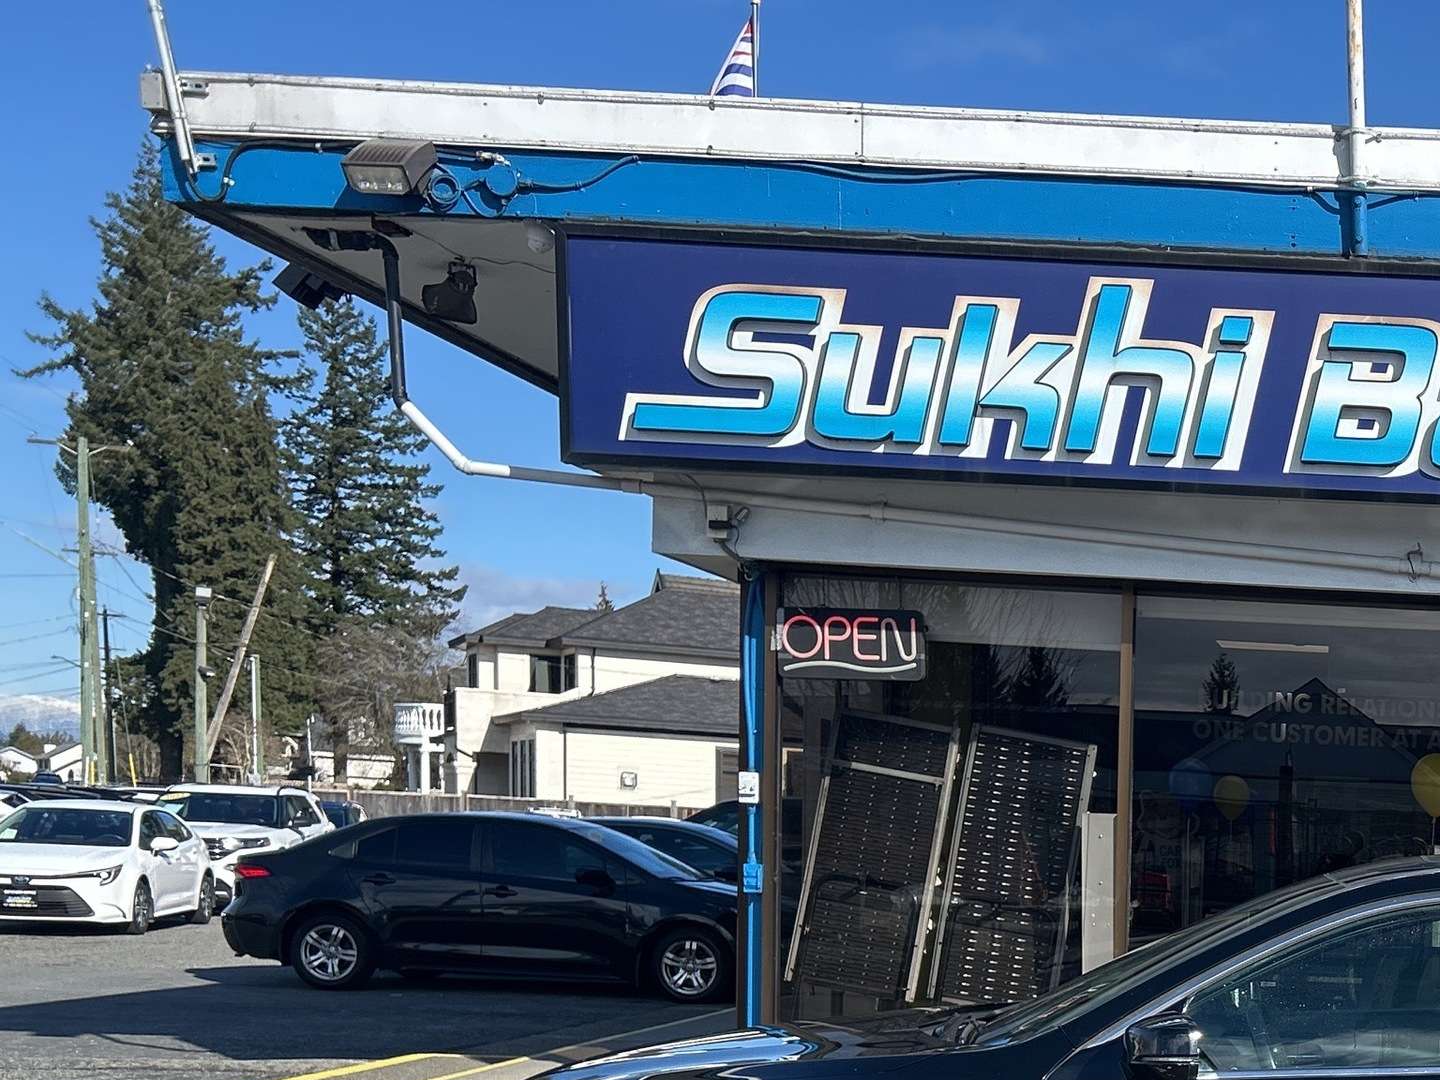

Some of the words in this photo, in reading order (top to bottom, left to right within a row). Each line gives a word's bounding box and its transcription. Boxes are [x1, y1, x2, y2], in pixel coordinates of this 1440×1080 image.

[618, 277, 1276, 471] Sukhi
[782, 615, 917, 661] OPEN
[1253, 721, 1385, 747] CUSTOMER
